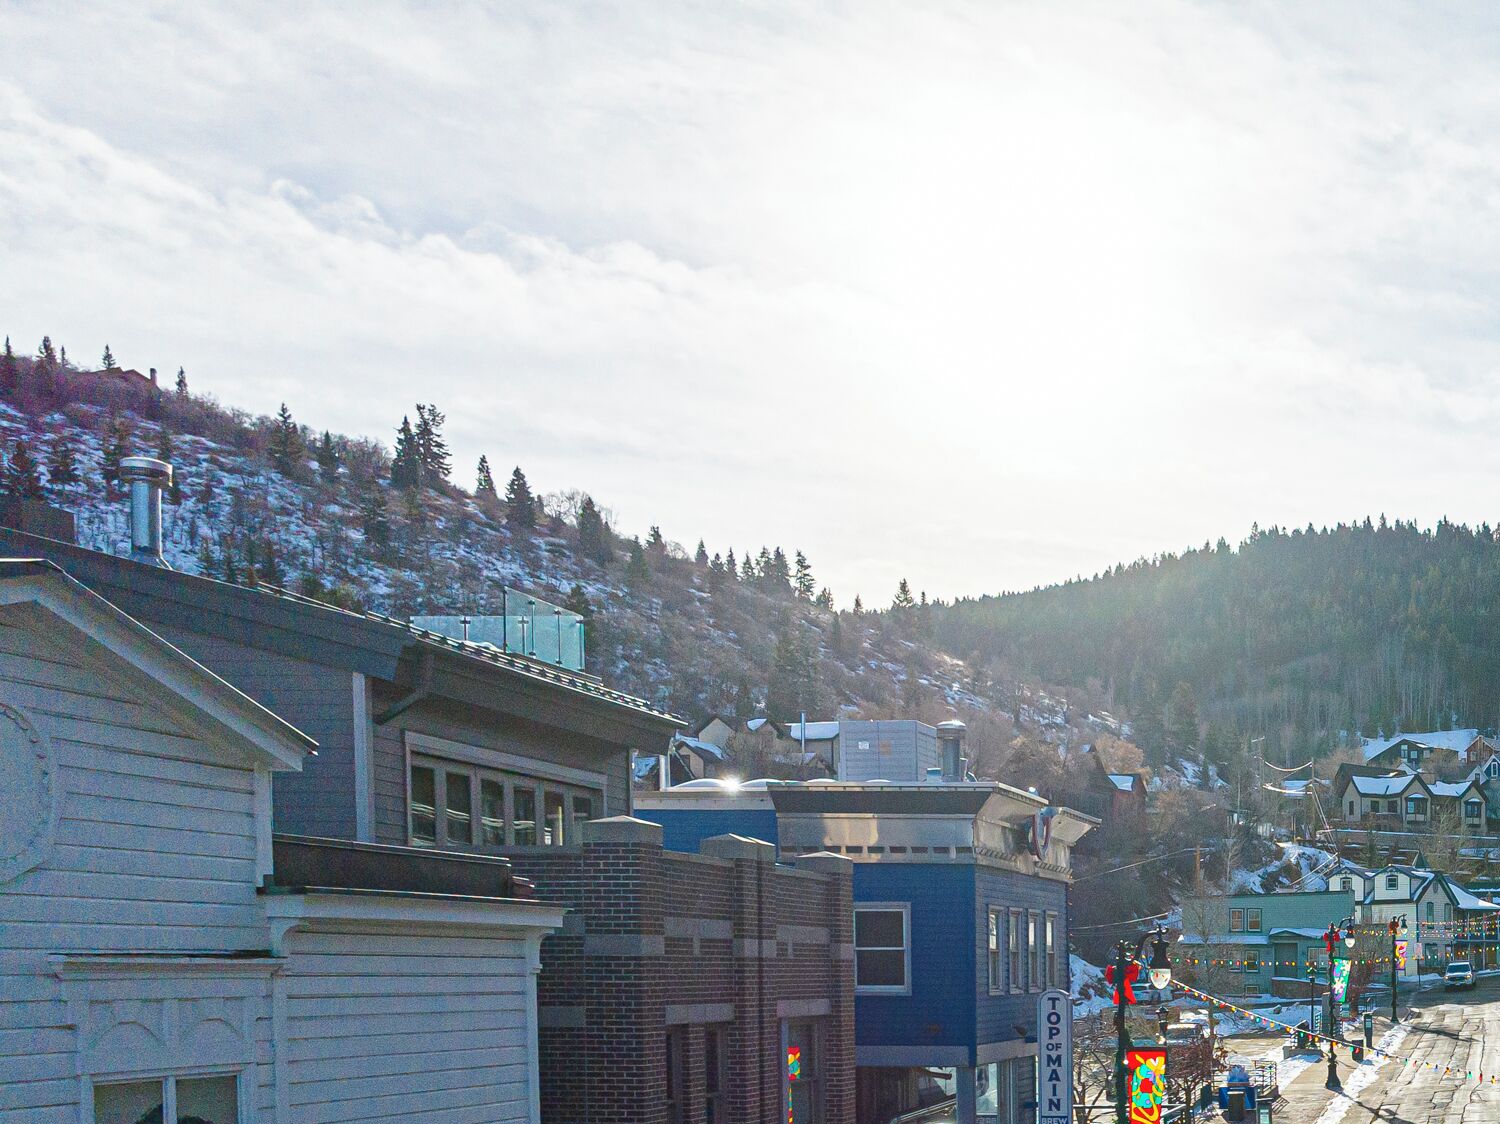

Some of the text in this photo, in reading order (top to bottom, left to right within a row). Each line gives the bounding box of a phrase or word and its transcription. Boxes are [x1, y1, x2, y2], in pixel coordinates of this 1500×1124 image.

[1046, 997, 1062, 1112] TOP OF MAIN
[1041, 1117, 1068, 1124] BREW
